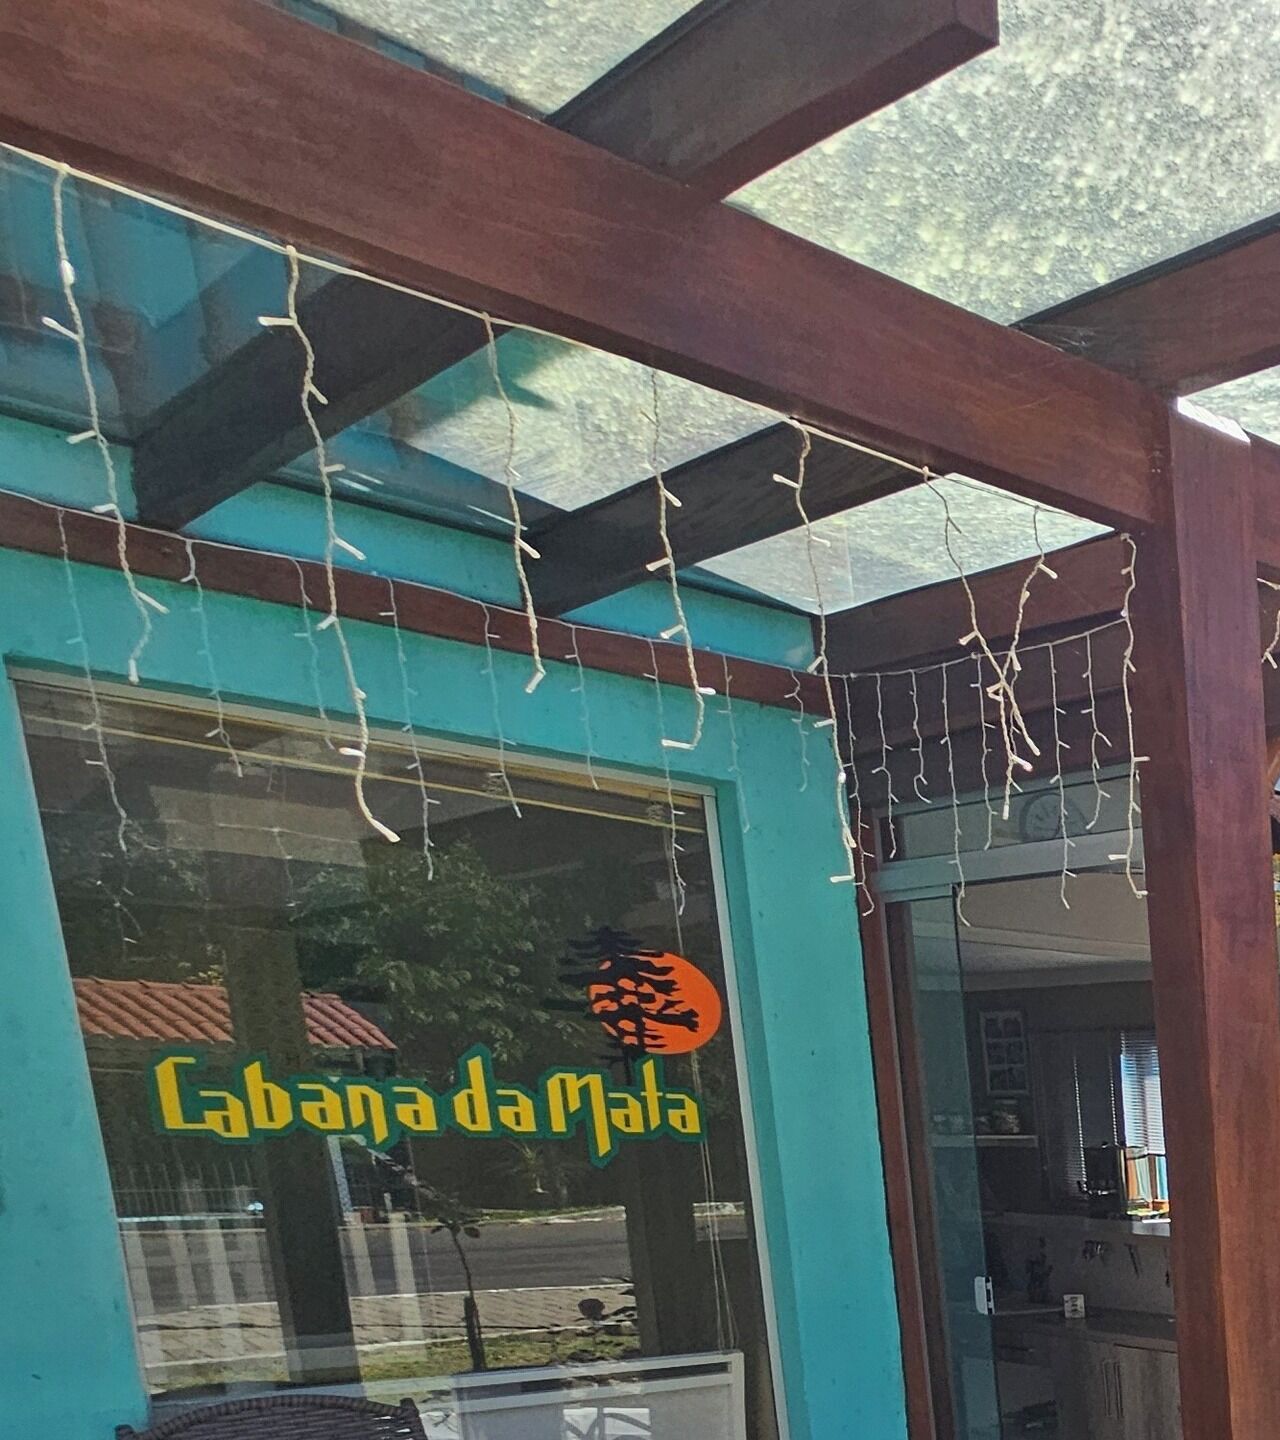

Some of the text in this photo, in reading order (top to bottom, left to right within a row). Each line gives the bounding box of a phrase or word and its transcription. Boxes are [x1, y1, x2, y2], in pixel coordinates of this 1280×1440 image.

[154, 1055, 701, 1157] Cabana da Mata
